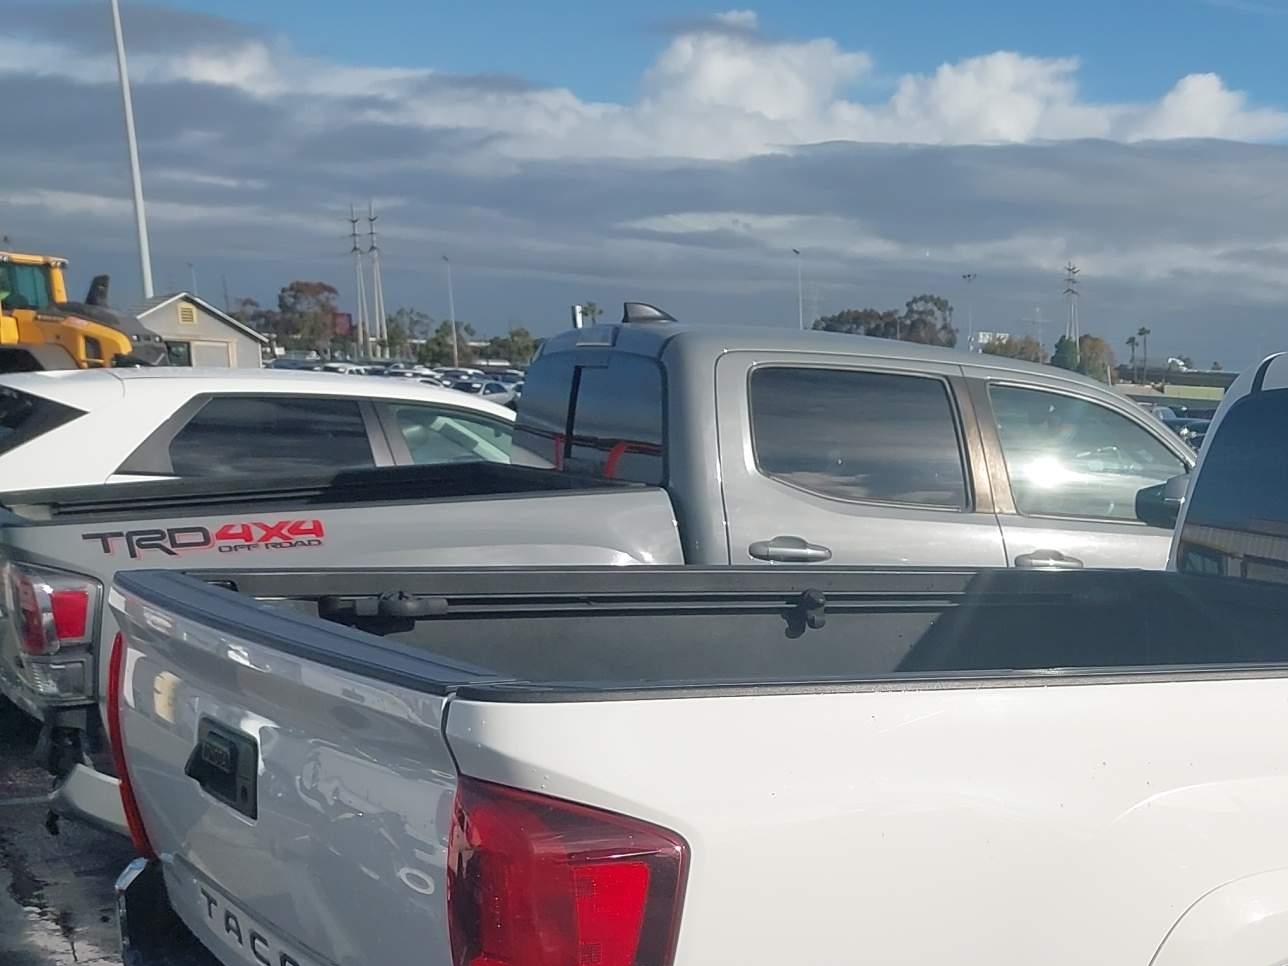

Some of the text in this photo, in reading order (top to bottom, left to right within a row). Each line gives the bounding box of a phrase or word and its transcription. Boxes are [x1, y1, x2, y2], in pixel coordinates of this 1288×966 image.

[81, 526, 212, 559] TRD
[218, 538, 322, 553] OFF ROAD
